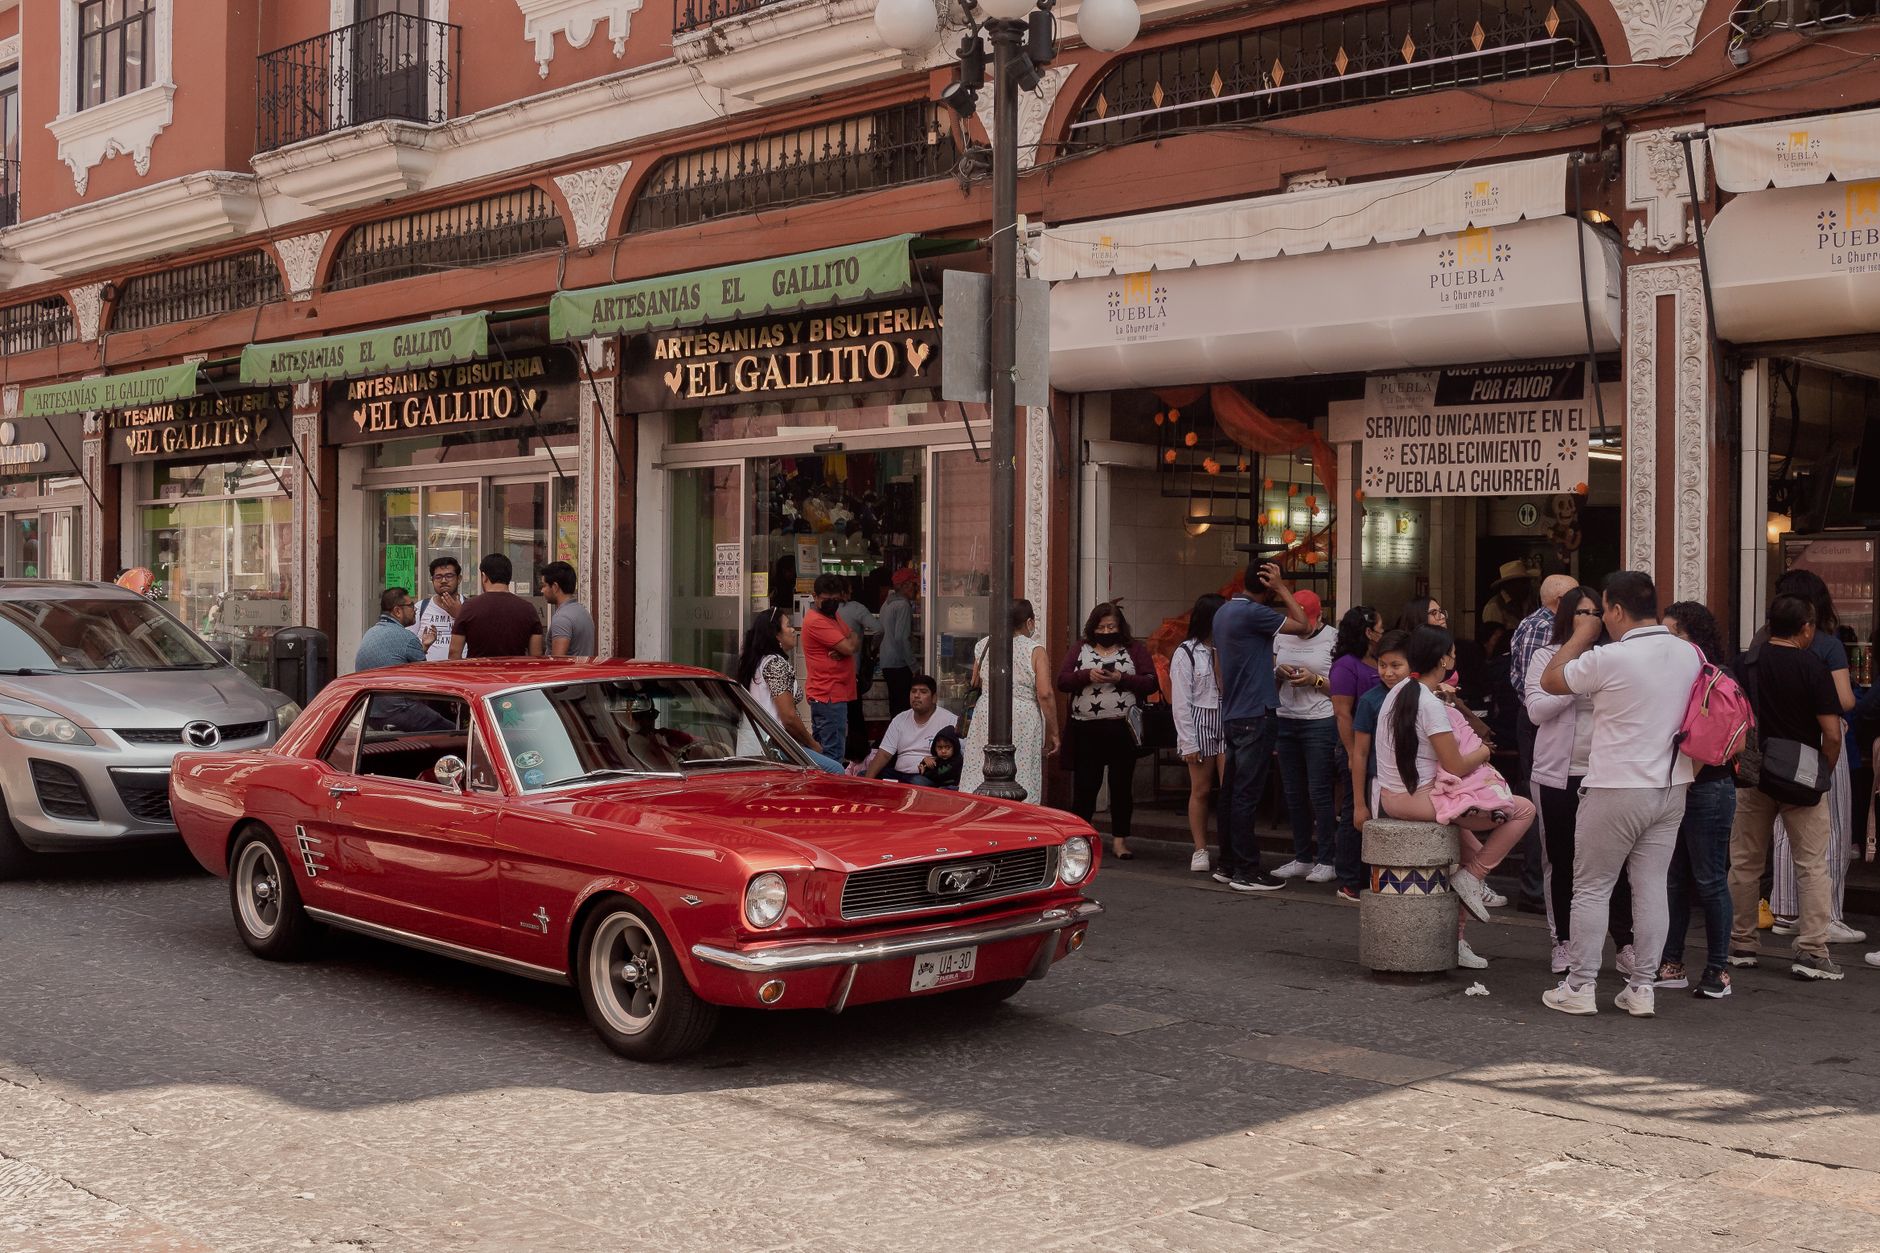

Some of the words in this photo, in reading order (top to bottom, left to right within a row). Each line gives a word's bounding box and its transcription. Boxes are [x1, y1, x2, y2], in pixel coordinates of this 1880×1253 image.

[1777, 151, 1819, 161] PUEBLA
[1465, 198, 1499, 209] PUEBLA
[1831, 253, 1842, 265] La
[1847, 250, 1880, 264] Churr
[592, 283, 701, 325] ARTESANIAS
[721, 276, 746, 305] EL
[772, 256, 860, 298] GALLITO
[1430, 267, 1505, 289] PUEBLA
[1440, 291, 1449, 302] La
[1108, 305, 1167, 322] PUEBLA
[269, 344, 345, 374] ARTESANIAS
[359, 340, 376, 363] EL
[393, 327, 452, 358] GALLITO
[654, 323, 785, 361] ARTESANIAS
[788, 320, 804, 344] Y
[347, 369, 438, 401] ARTESANIAS
[442, 367, 452, 389] Y
[456, 355, 545, 386] BISUTERIA
[686, 360, 728, 399] EL
[734, 340, 896, 393] GALLITO
[105, 384, 117, 403] EL
[1380, 381, 1432, 394] PUEBLA
[1470, 378, 1502, 401] POR
[1503, 375, 1554, 400] FAVOR
[187, 402, 197, 419] Y
[368, 400, 398, 433] EL
[403, 385, 513, 429] GALLITO
[134, 428, 159, 455] EL
[162, 416, 250, 454] GALLITO
[1365, 414, 1431, 439] SERVICIO
[1436, 409, 1537, 437] UNICAMENTE
[1542, 408, 1563, 433] EN
[1568, 407, 1588, 432] EL
[1400, 439, 1542, 466] ESTABLECIMIENTO
[1385, 470, 1443, 494] PUEBLA
[1447, 469, 1466, 493] LA
[1470, 462, 1561, 493] CHURRERÍA
